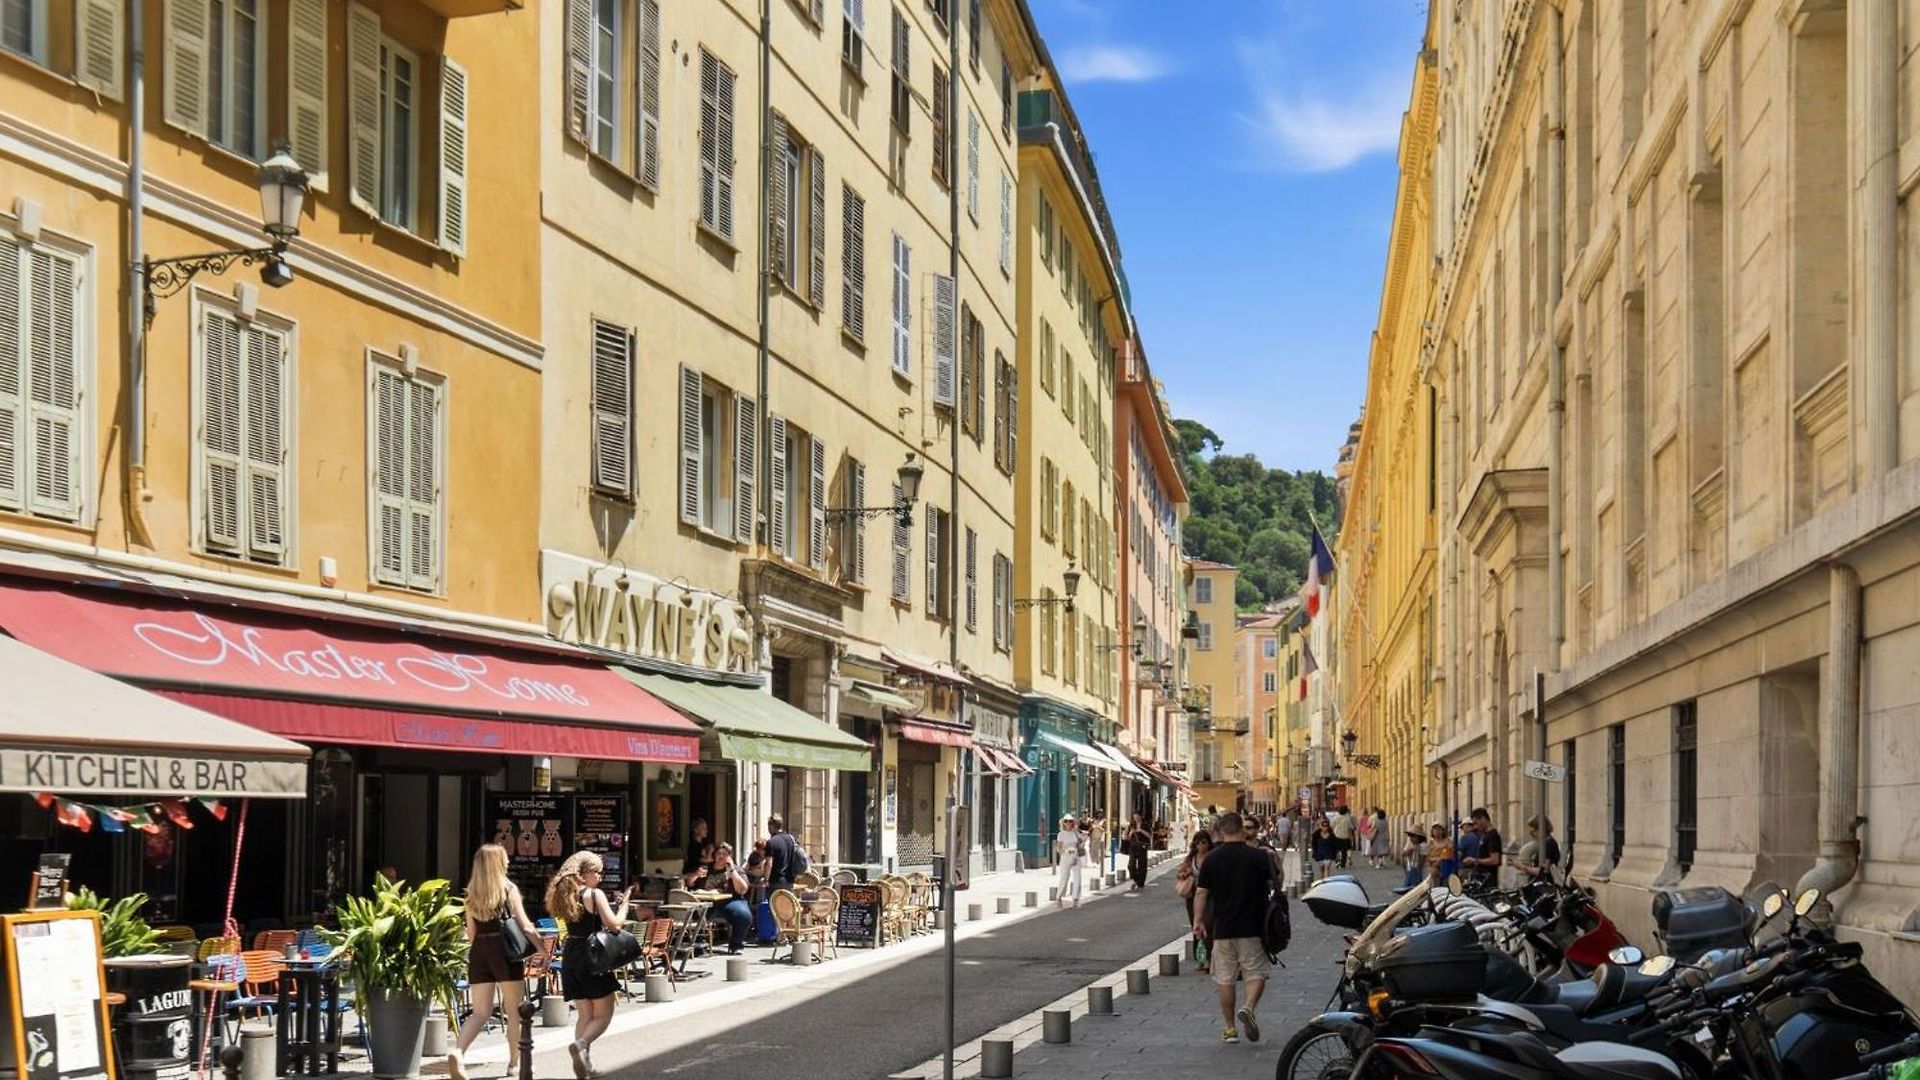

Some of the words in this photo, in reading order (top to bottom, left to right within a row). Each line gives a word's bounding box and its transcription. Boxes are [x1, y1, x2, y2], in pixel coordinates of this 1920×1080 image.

[133, 611, 396, 686] Master
[397, 653, 590, 707] Home
[573, 580, 724, 671] WAYNE'S
[25, 753, 159, 790] KITCHEN
[168, 759, 186, 790] &
[194, 760, 248, 792] BAR
